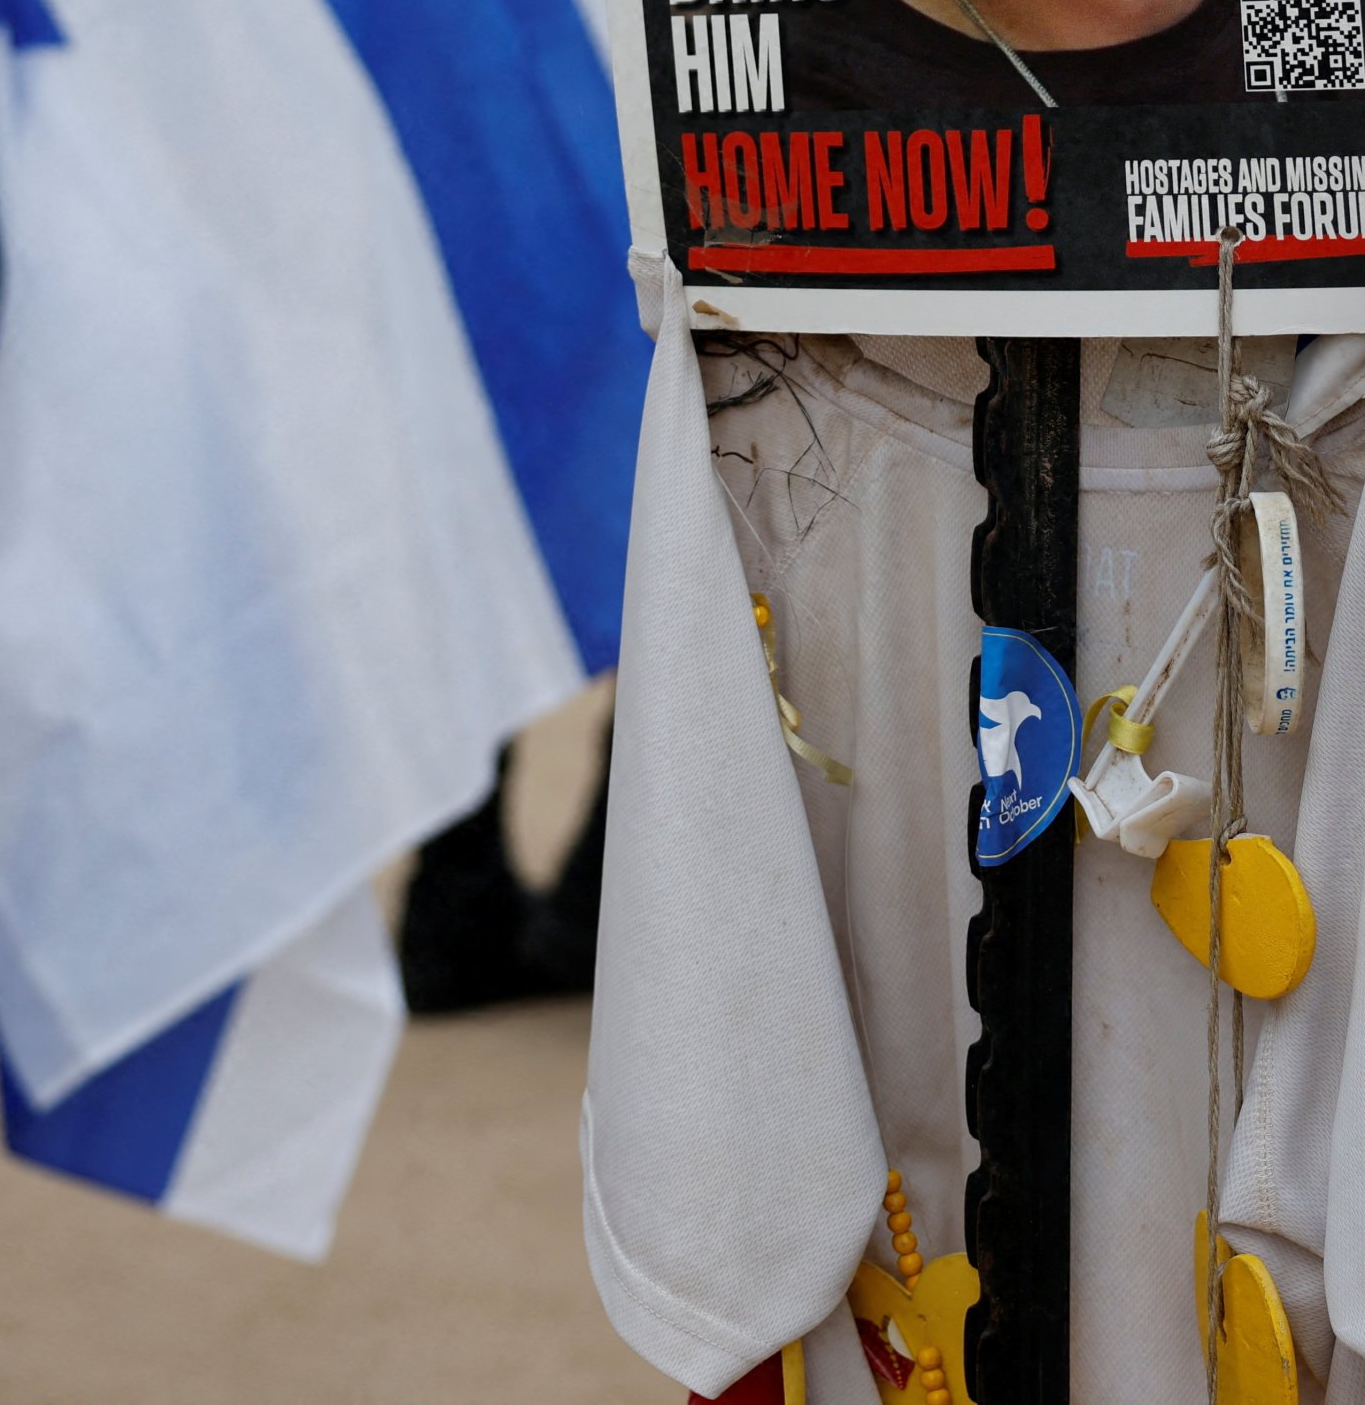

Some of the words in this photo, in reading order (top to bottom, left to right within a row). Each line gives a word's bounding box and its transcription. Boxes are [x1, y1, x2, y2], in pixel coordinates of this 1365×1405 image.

[670, 13, 785, 114] HIM
[681, 131, 849, 230] HOME
[864, 114, 1051, 231] NOW!
[1125, 157, 1233, 195] HOSTAGES
[1237, 157, 1281, 194] AND
[1127, 192, 1267, 243] FAMILIES
[1283, 592, 1295, 623] עומר
[1282, 627, 1296, 673] הביתה!
